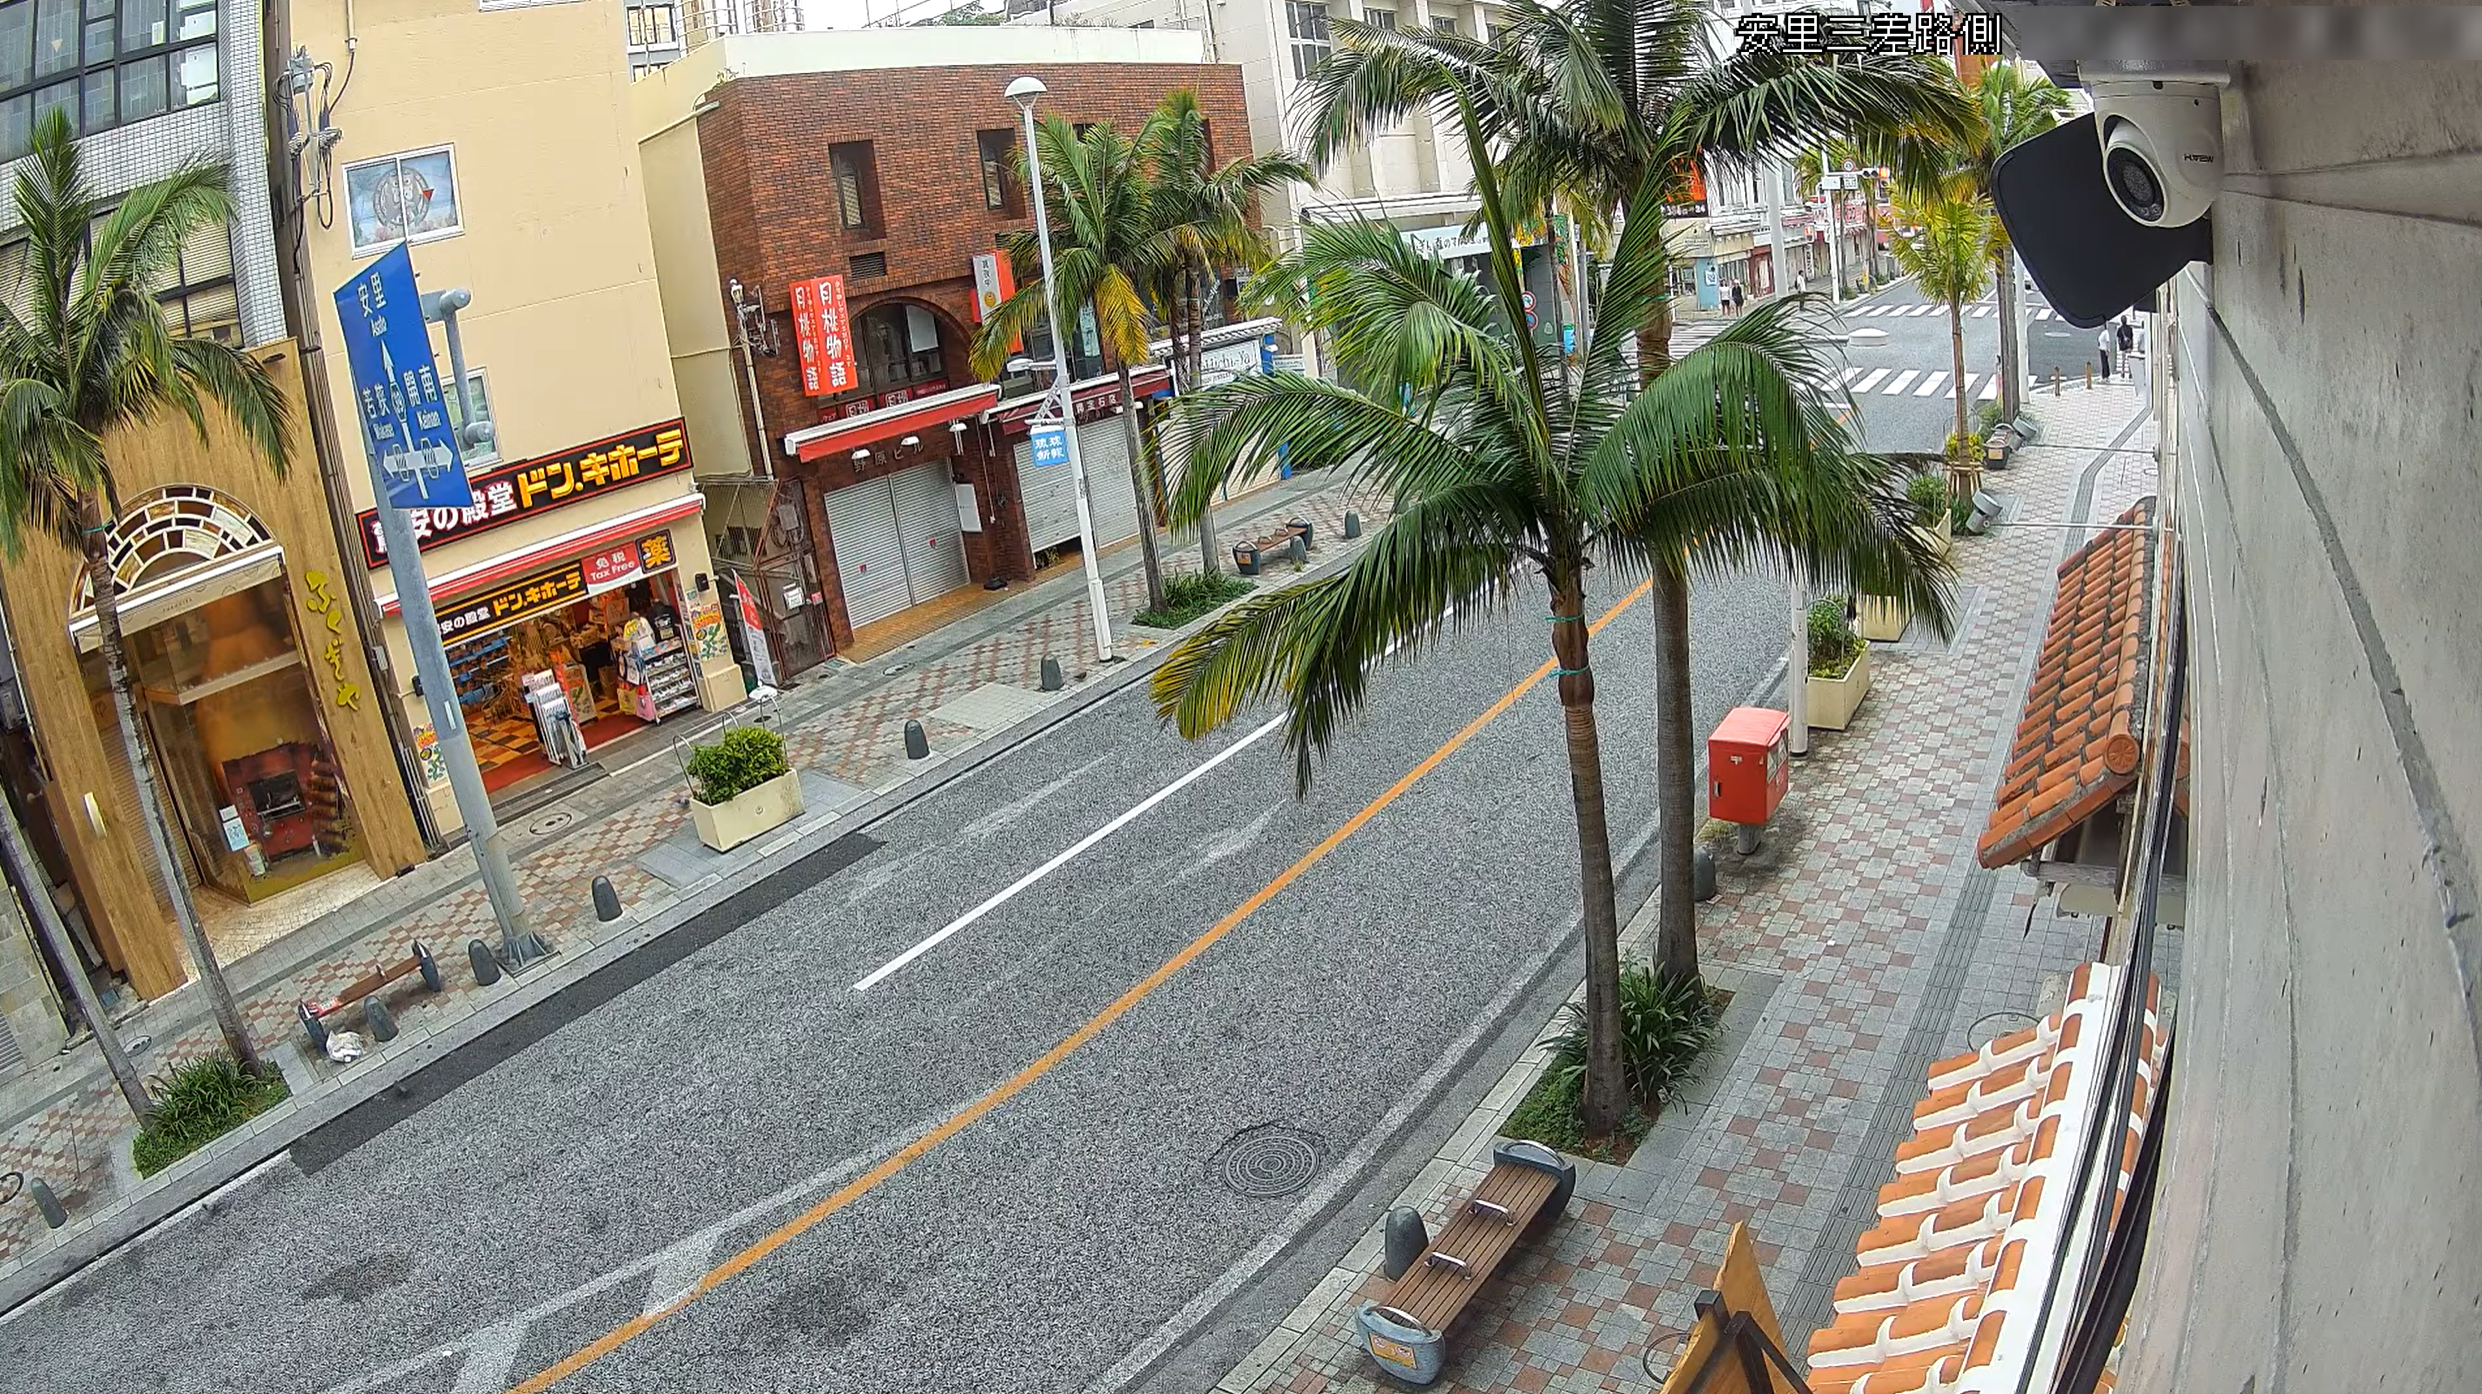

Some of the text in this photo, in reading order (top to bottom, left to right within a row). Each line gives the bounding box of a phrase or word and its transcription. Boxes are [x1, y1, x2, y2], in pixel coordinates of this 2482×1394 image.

[358, 271, 387, 318] 安里
[819, 281, 847, 388] 月桃物語
[596, 550, 627, 570] 免税
[641, 535, 672, 568] 薬
[590, 560, 636, 581] Tax Free
[437, 606, 491, 636] 安の殿堂
